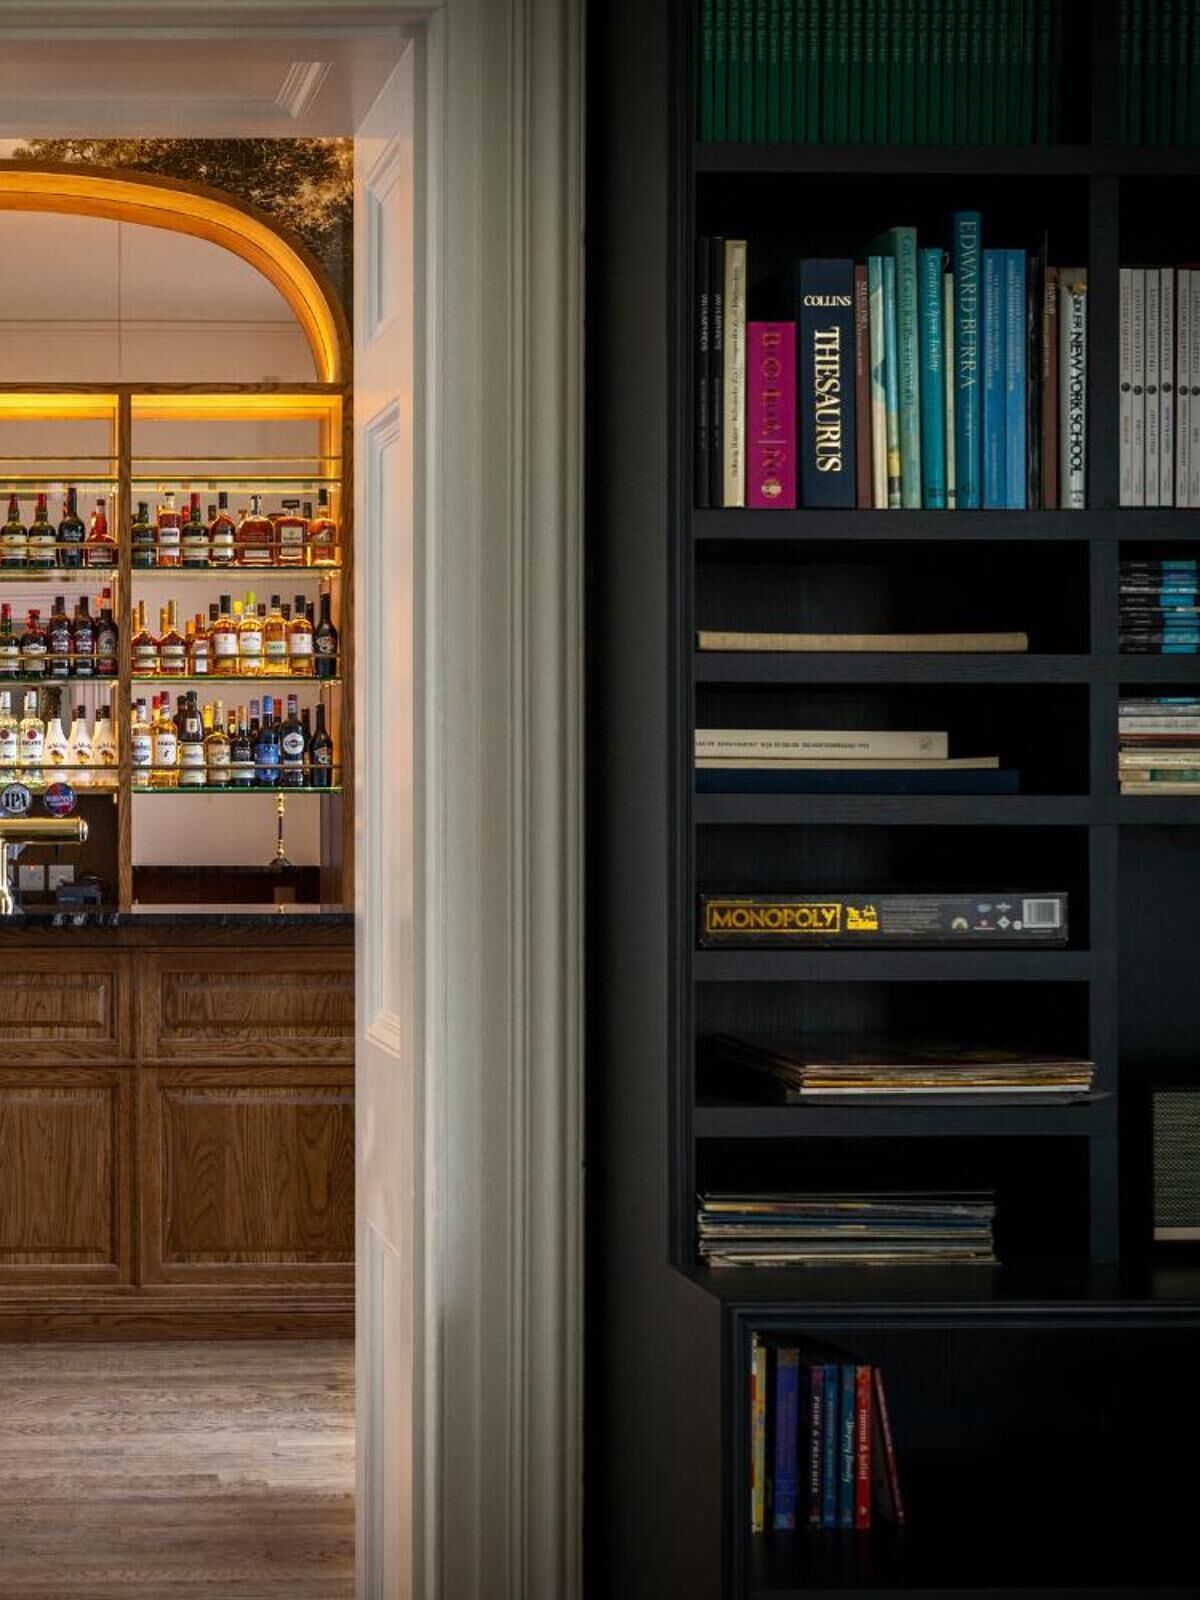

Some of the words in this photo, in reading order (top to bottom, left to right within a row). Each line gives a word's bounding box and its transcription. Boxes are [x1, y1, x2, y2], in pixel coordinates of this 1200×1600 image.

[959, 221, 976, 314] EDWARD
[803, 294, 852, 308] COLLINS
[960, 319, 977, 390] BURRA
[1071, 331, 1084, 371] NEW
[812, 326, 842, 473] THESAURUS
[1071, 374, 1084, 411] YORK
[1071, 414, 1084, 475] SCHOOL
[4, 792, 28, 808] IPA
[711, 907, 837, 929] MONOPOLY
